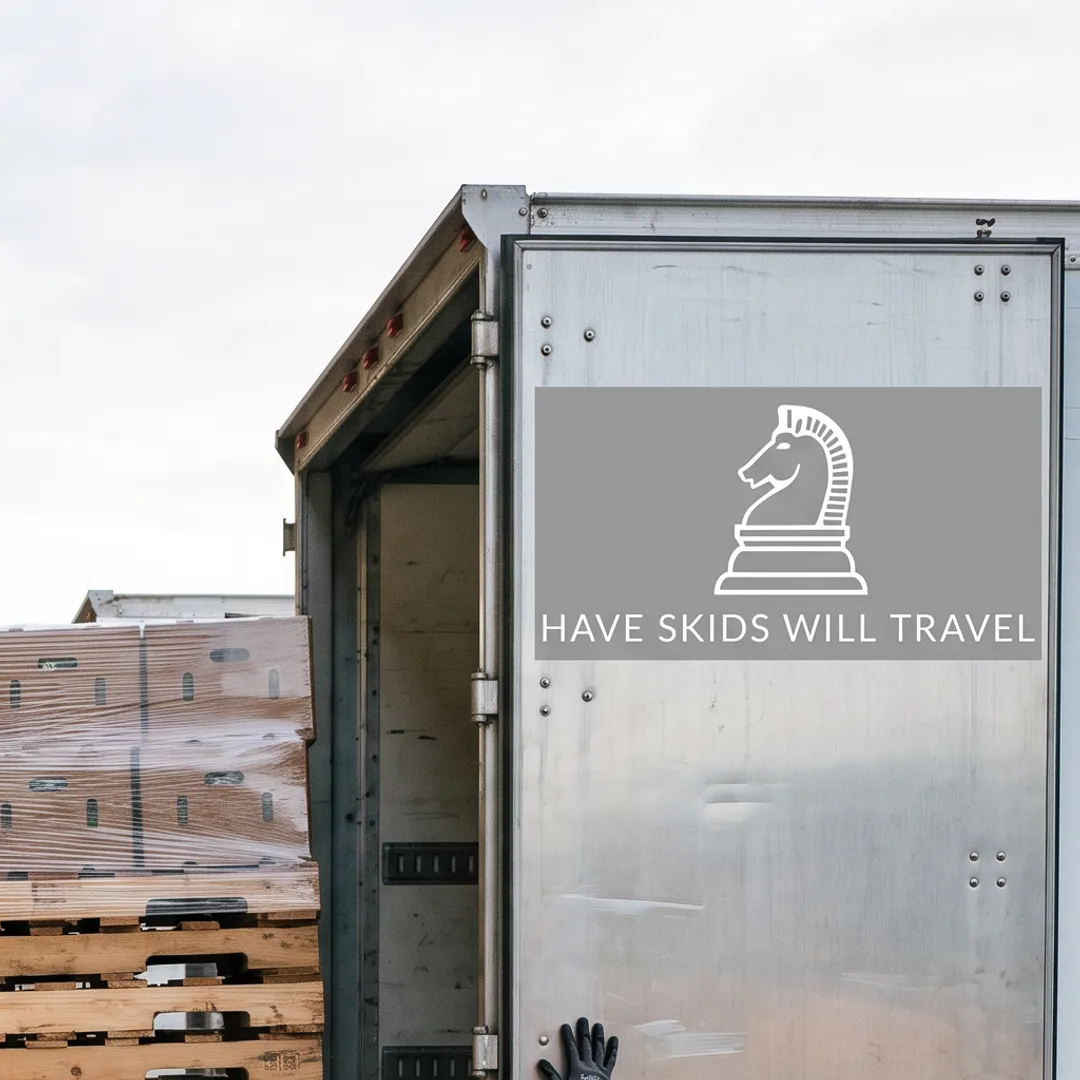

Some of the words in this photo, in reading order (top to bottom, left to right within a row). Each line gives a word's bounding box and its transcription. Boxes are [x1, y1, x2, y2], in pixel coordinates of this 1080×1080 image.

[541, 613, 644, 643] HAVE
[658, 613, 769, 643] SKIDS
[782, 613, 877, 643] WILL
[889, 613, 1036, 643] TRAVEL
